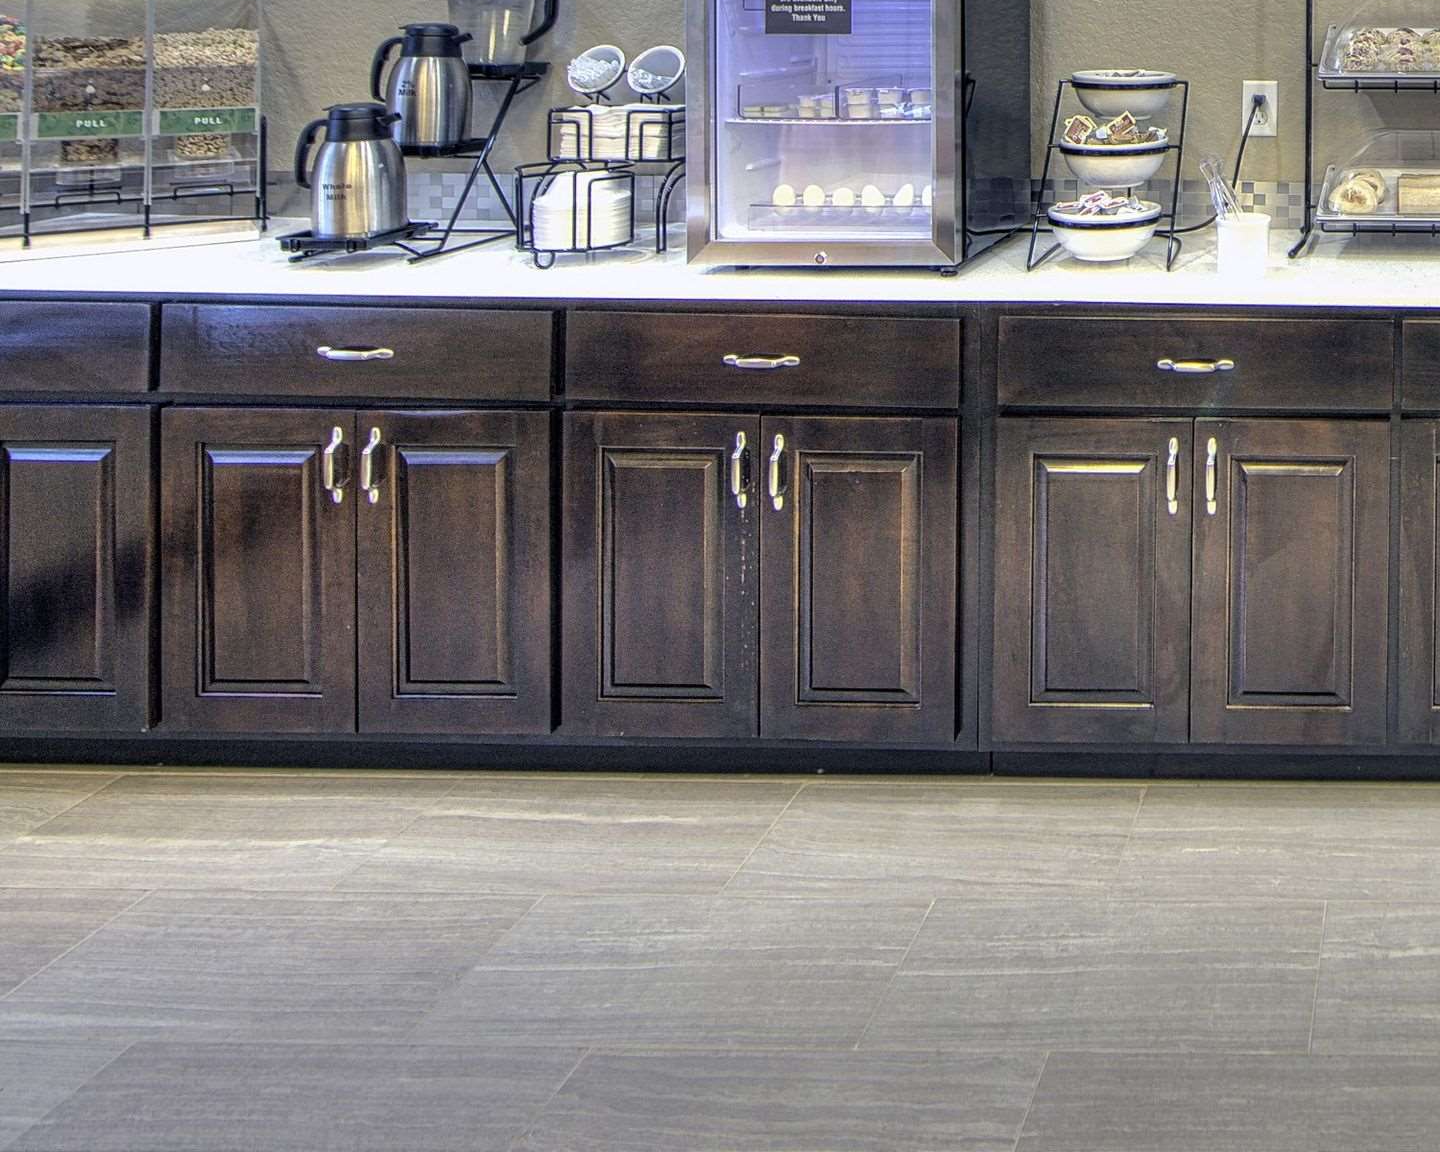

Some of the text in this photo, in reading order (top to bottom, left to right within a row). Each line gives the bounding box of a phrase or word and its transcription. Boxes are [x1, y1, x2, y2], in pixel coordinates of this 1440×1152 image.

[813, 14, 826, 22] You
[76, 120, 107, 128] PULL
[194, 117, 223, 125] PULL
